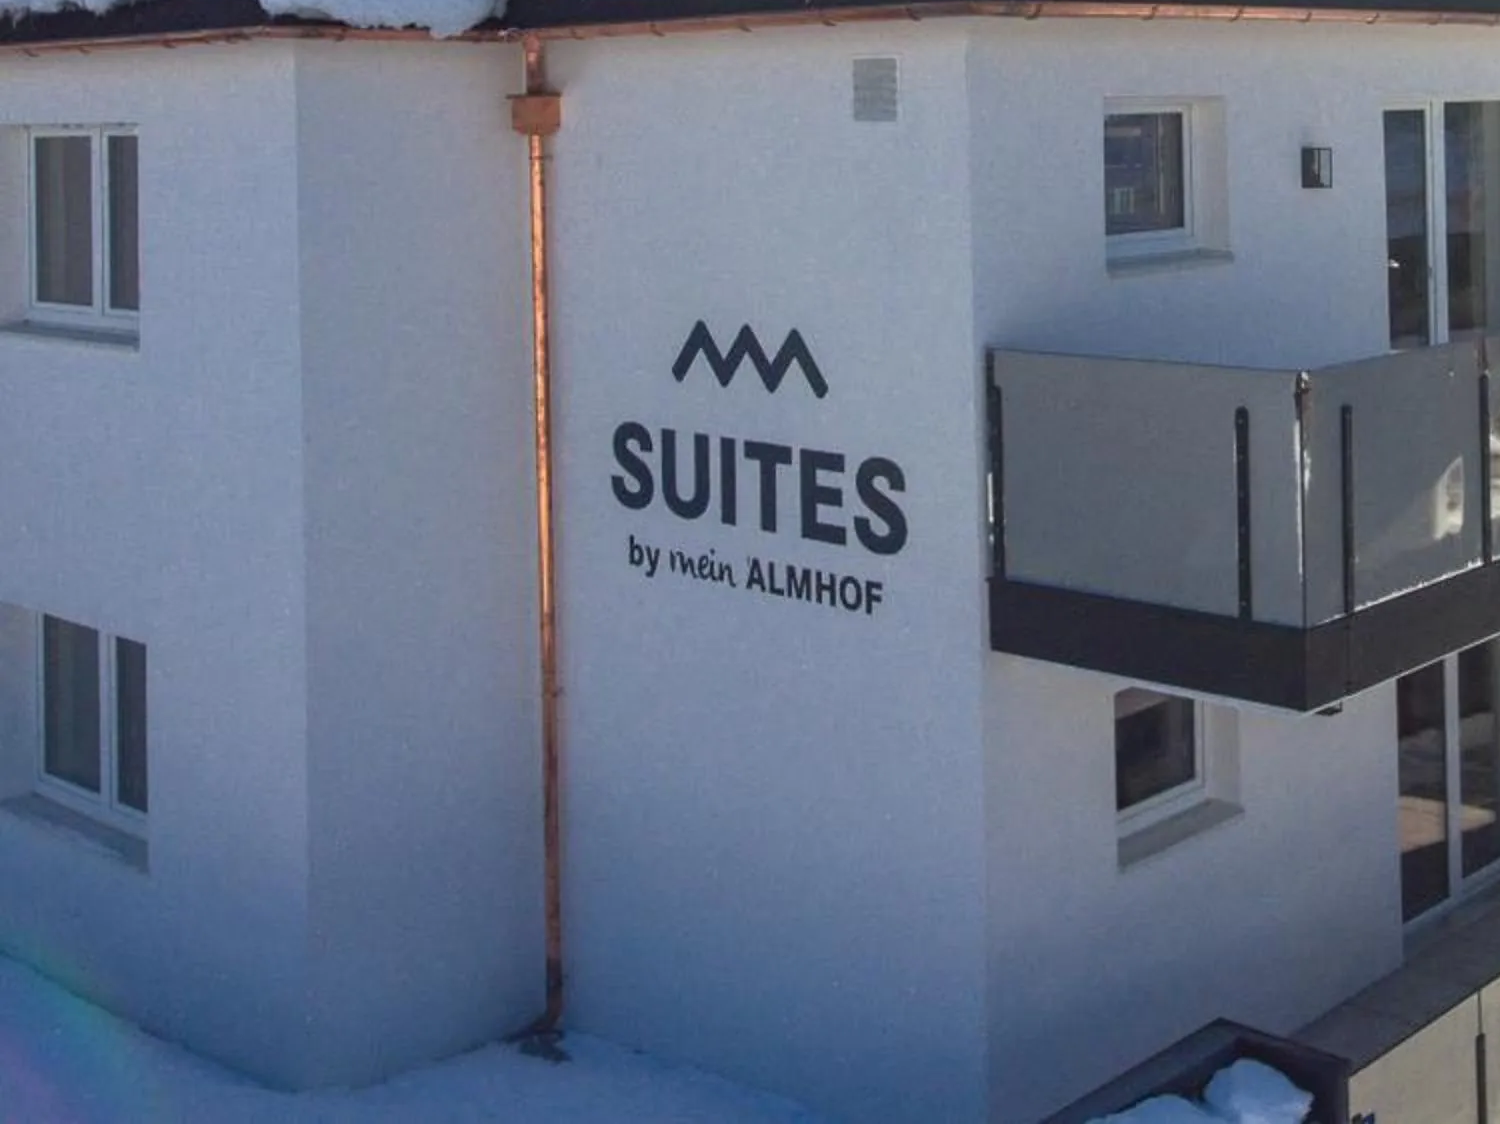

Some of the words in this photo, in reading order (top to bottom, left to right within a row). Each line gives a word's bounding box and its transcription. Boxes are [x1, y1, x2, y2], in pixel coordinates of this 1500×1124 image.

[611, 421, 908, 556] SUITES
[629, 534, 660, 578] by
[669, 549, 736, 588] mein
[746, 558, 883, 615] ALMHOF
